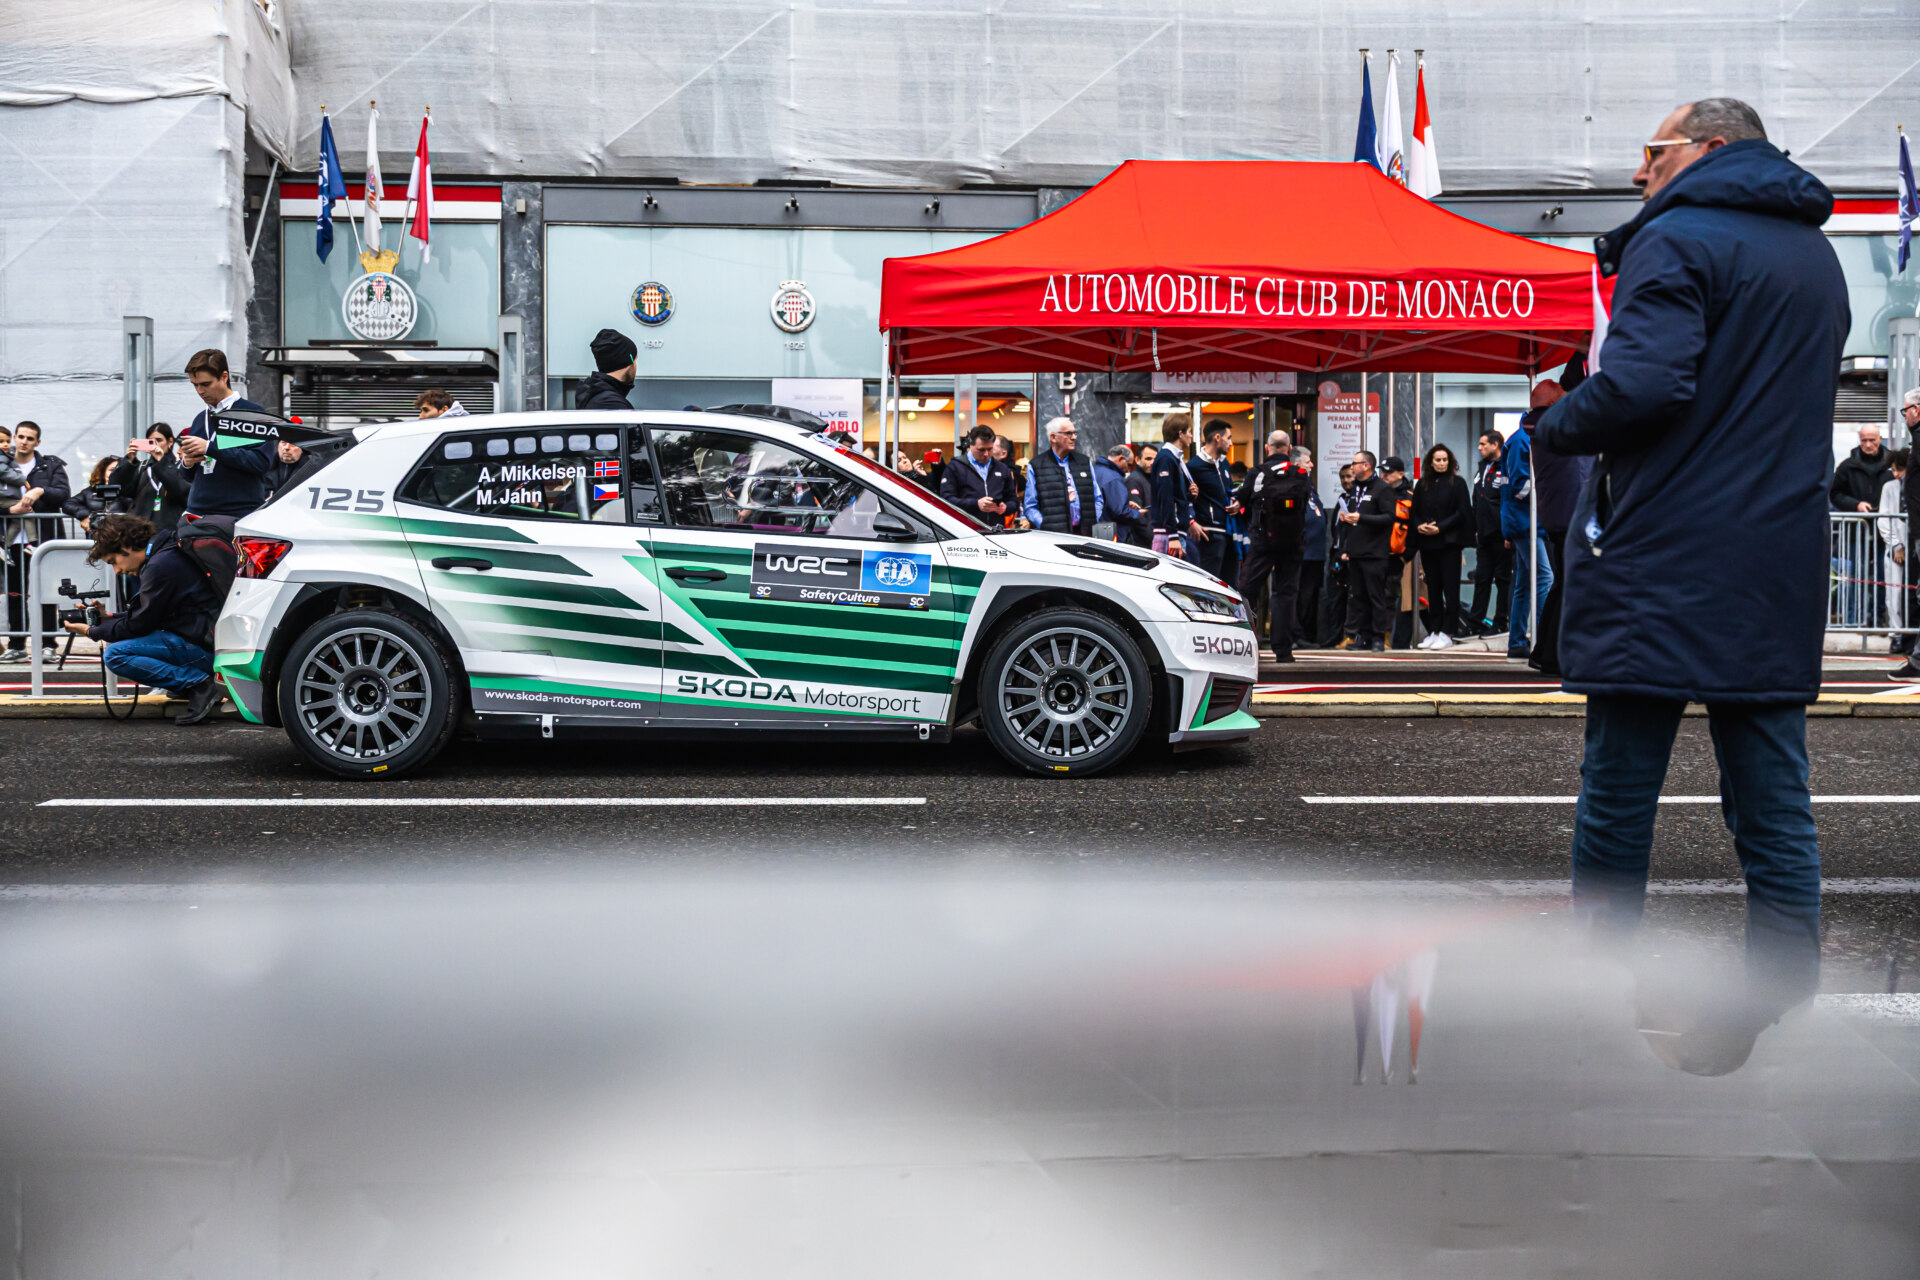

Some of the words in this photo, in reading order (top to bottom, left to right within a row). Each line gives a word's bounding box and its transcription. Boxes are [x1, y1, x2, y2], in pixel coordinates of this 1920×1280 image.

[1039, 273, 1247, 315] AUTOMOBILE
[1255, 277, 1338, 317] CLUB
[1346, 280, 1389, 318] DE
[1395, 278, 1535, 319] MONACO
[643, 339, 664, 349] 1907
[784, 340, 806, 351] 1925
[1059, 372, 1077, 389] B
[1165, 371, 1283, 385] PERMANENCE
[478, 467, 496, 483] A.
[501, 463, 587, 482] Mikkelsen
[308, 486, 386, 513] 125
[476, 489, 497, 506] M.
[500, 488, 542, 505] Jahn
[984, 548, 1008, 557] 125
[765, 553, 849, 576] WRC
[756, 586, 772, 596] SC
[800, 588, 881, 604] SafetyCulture
[909, 596, 925, 606] SC
[484, 690, 642, 709] www.skoda-motorsport.com
[804, 686, 921, 714] Motorsport
